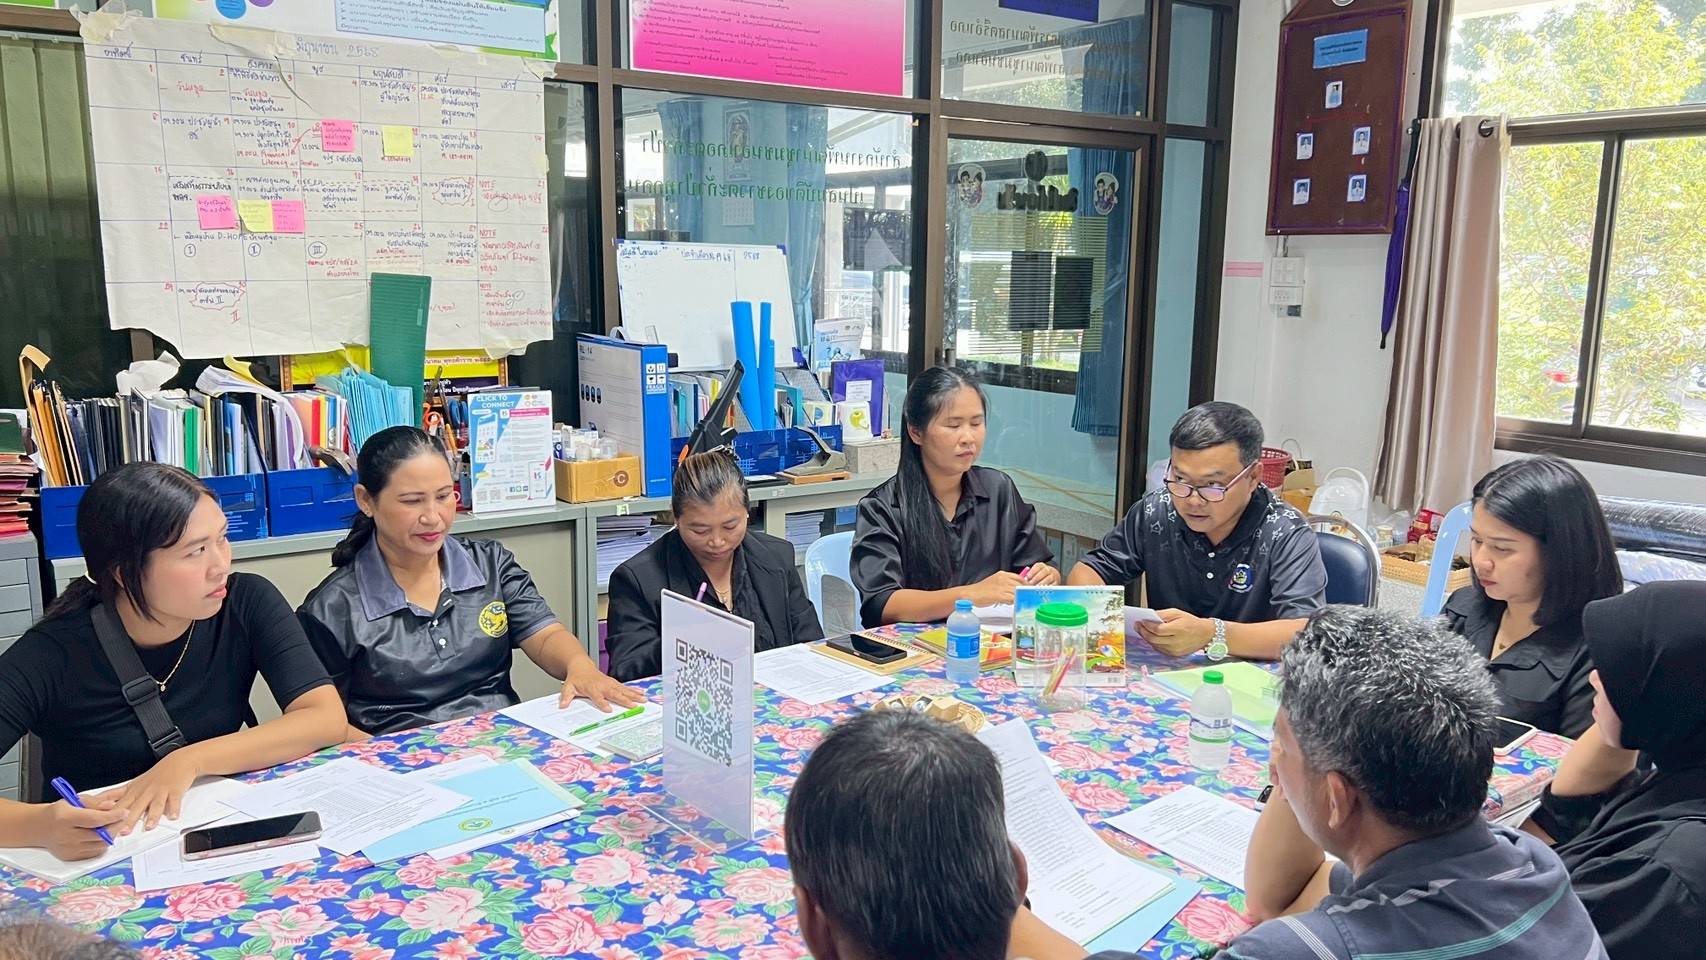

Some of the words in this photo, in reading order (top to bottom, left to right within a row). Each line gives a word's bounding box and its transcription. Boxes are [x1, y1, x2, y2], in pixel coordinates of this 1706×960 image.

[296, 39, 338, 60] มิถุนายน
[354, 222, 363, 230] 25
[217, 233, 248, 241] D-HOPE
[480, 229, 497, 238] NOTE
[476, 395, 498, 403] CLICK
[499, 394, 508, 402] TO
[481, 401, 515, 410] CONNECT
